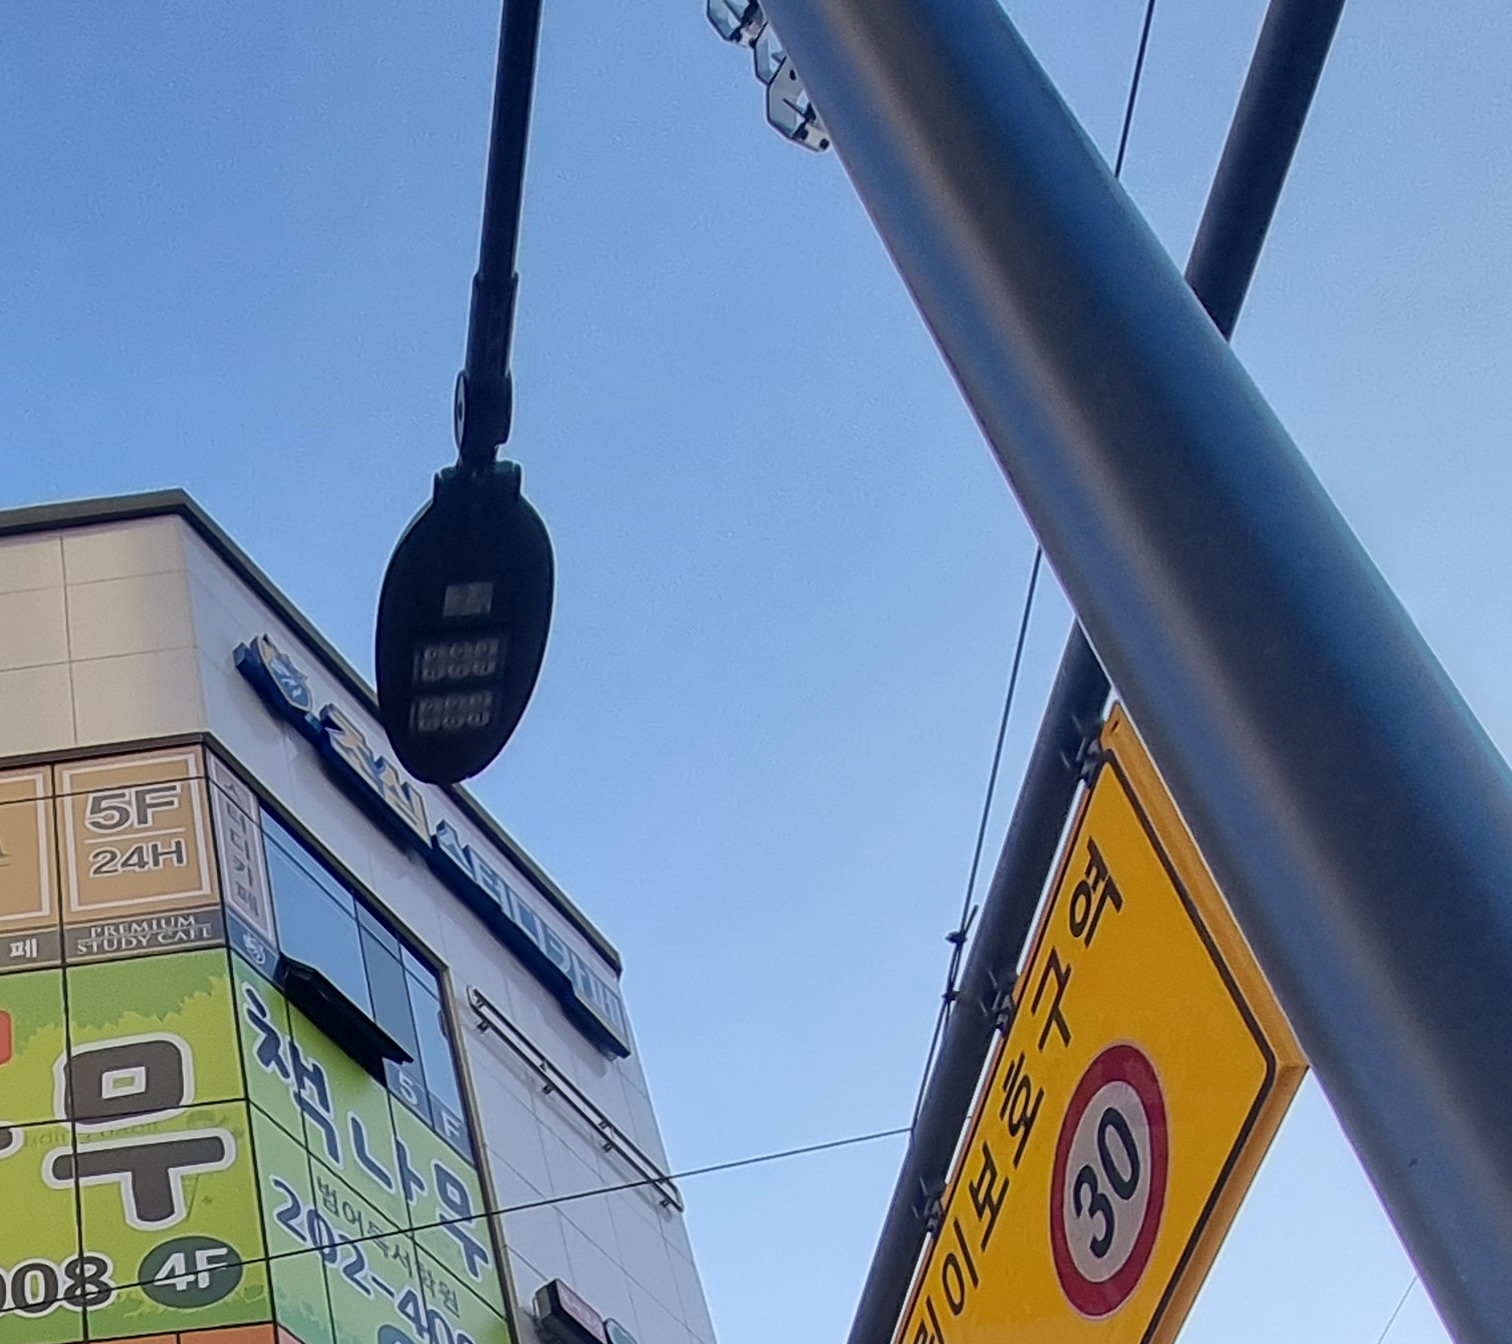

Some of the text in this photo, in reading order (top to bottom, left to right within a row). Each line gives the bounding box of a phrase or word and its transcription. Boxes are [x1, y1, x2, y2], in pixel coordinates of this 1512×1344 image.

[89, 785, 179, 831] 5F
[91, 840, 185, 877] 24H
[76, 931, 152, 954] STUDY
[91, 914, 197, 940] PREMIUM
[246, 988, 488, 1279] 책나무
[1072, 1106, 1142, 1258] 30
[152, 1247, 236, 1299] 4F
